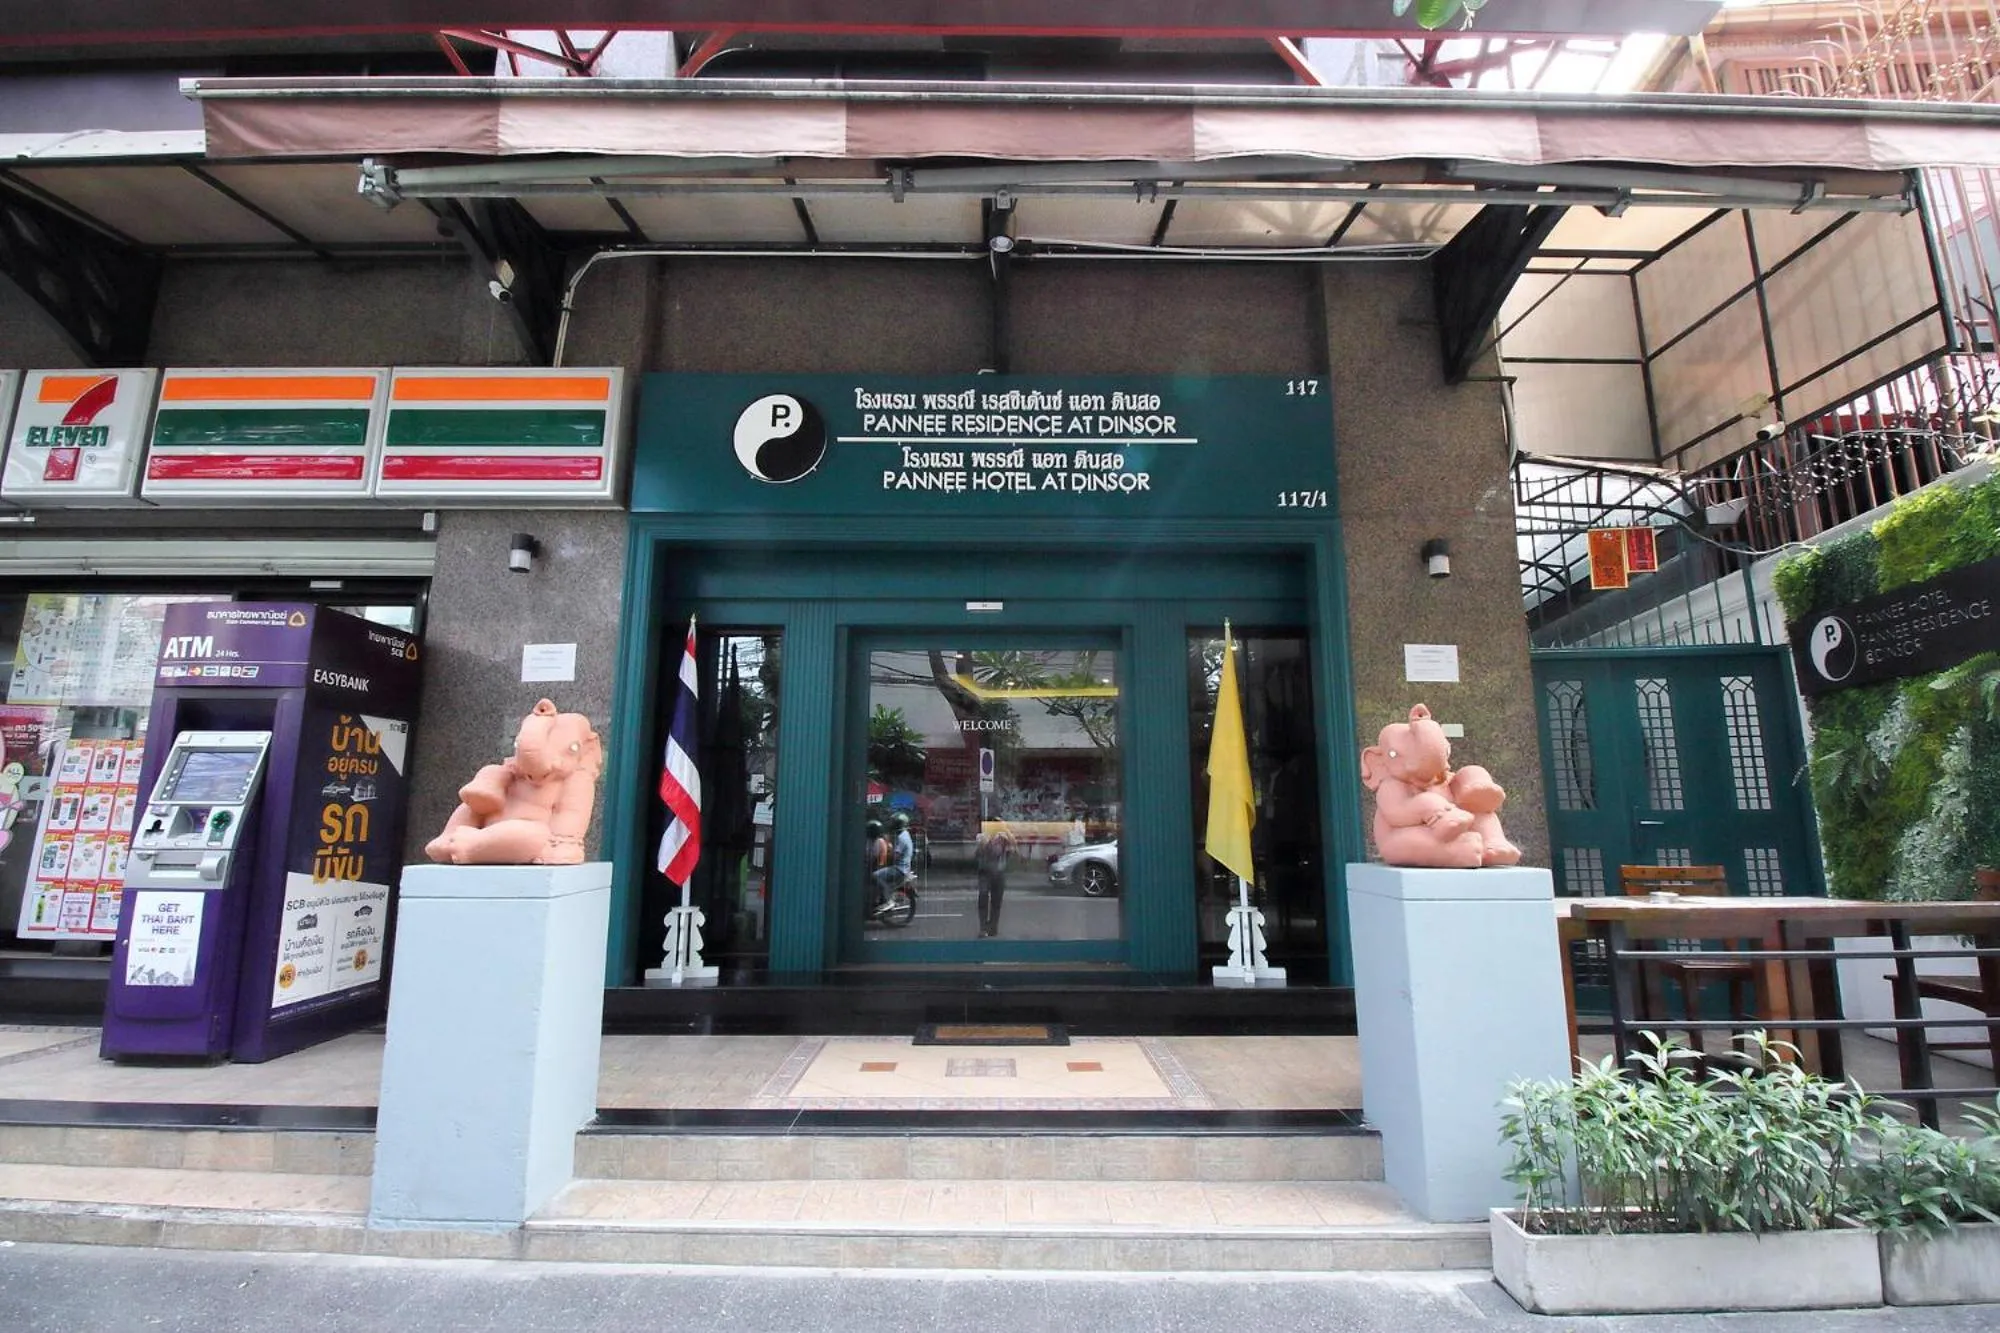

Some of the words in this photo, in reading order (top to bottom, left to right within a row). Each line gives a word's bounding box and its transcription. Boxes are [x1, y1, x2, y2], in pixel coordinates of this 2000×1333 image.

[1285, 379, 1319, 396] 117
[854, 387, 916, 410] โรงแรม
[922, 388, 976, 411] พรรณี
[1067, 394, 1105, 412] แอท
[1111, 391, 1161, 412] ดินสอ
[863, 413, 946, 434] PANNEE
[951, 414, 1063, 435] RESIDENCE
[1067, 415, 1093, 434] AT
[1098, 415, 1177, 435] DINSOR
[901, 446, 964, 469] โรงแรม
[971, 448, 1024, 470] พรรณี
[1032, 452, 1067, 470] แอท
[1074, 450, 1124, 471] ดินสอ
[883, 471, 967, 491] PANNEE
[973, 471, 1036, 491] HOTEL
[1041, 471, 1066, 490] AT
[1071, 472, 1151, 492] DINSOR
[1277, 490, 1328, 508] 117/1
[163, 635, 214, 659] ATM
[313, 668, 370, 692] EASYBANK
[331, 714, 383, 754] บ้าน
[952, 719, 1012, 731] WELCOME
[327, 752, 379, 781] อยู่ครบ
[319, 803, 369, 844] รถ
[158, 903, 181, 913] GET
[286, 899, 306, 911] SCB
[142, 914, 164, 924] THAI
[152, 925, 180, 936] HERE
